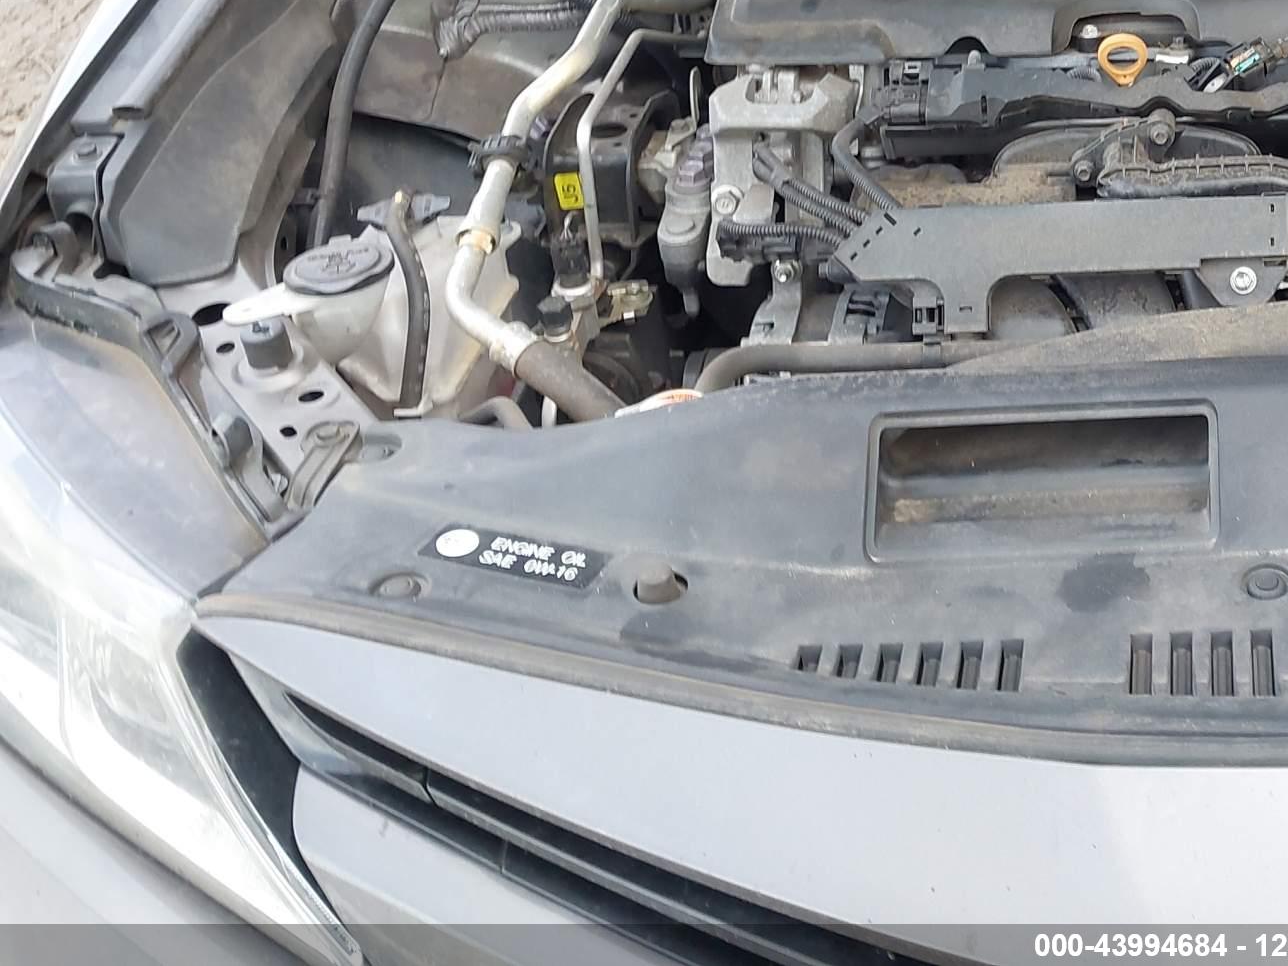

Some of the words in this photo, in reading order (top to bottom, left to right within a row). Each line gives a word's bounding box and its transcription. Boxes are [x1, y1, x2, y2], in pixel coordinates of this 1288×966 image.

[479, 550, 517, 568] SAE
[491, 536, 555, 560] ENGINE
[561, 551, 586, 567] OIL
